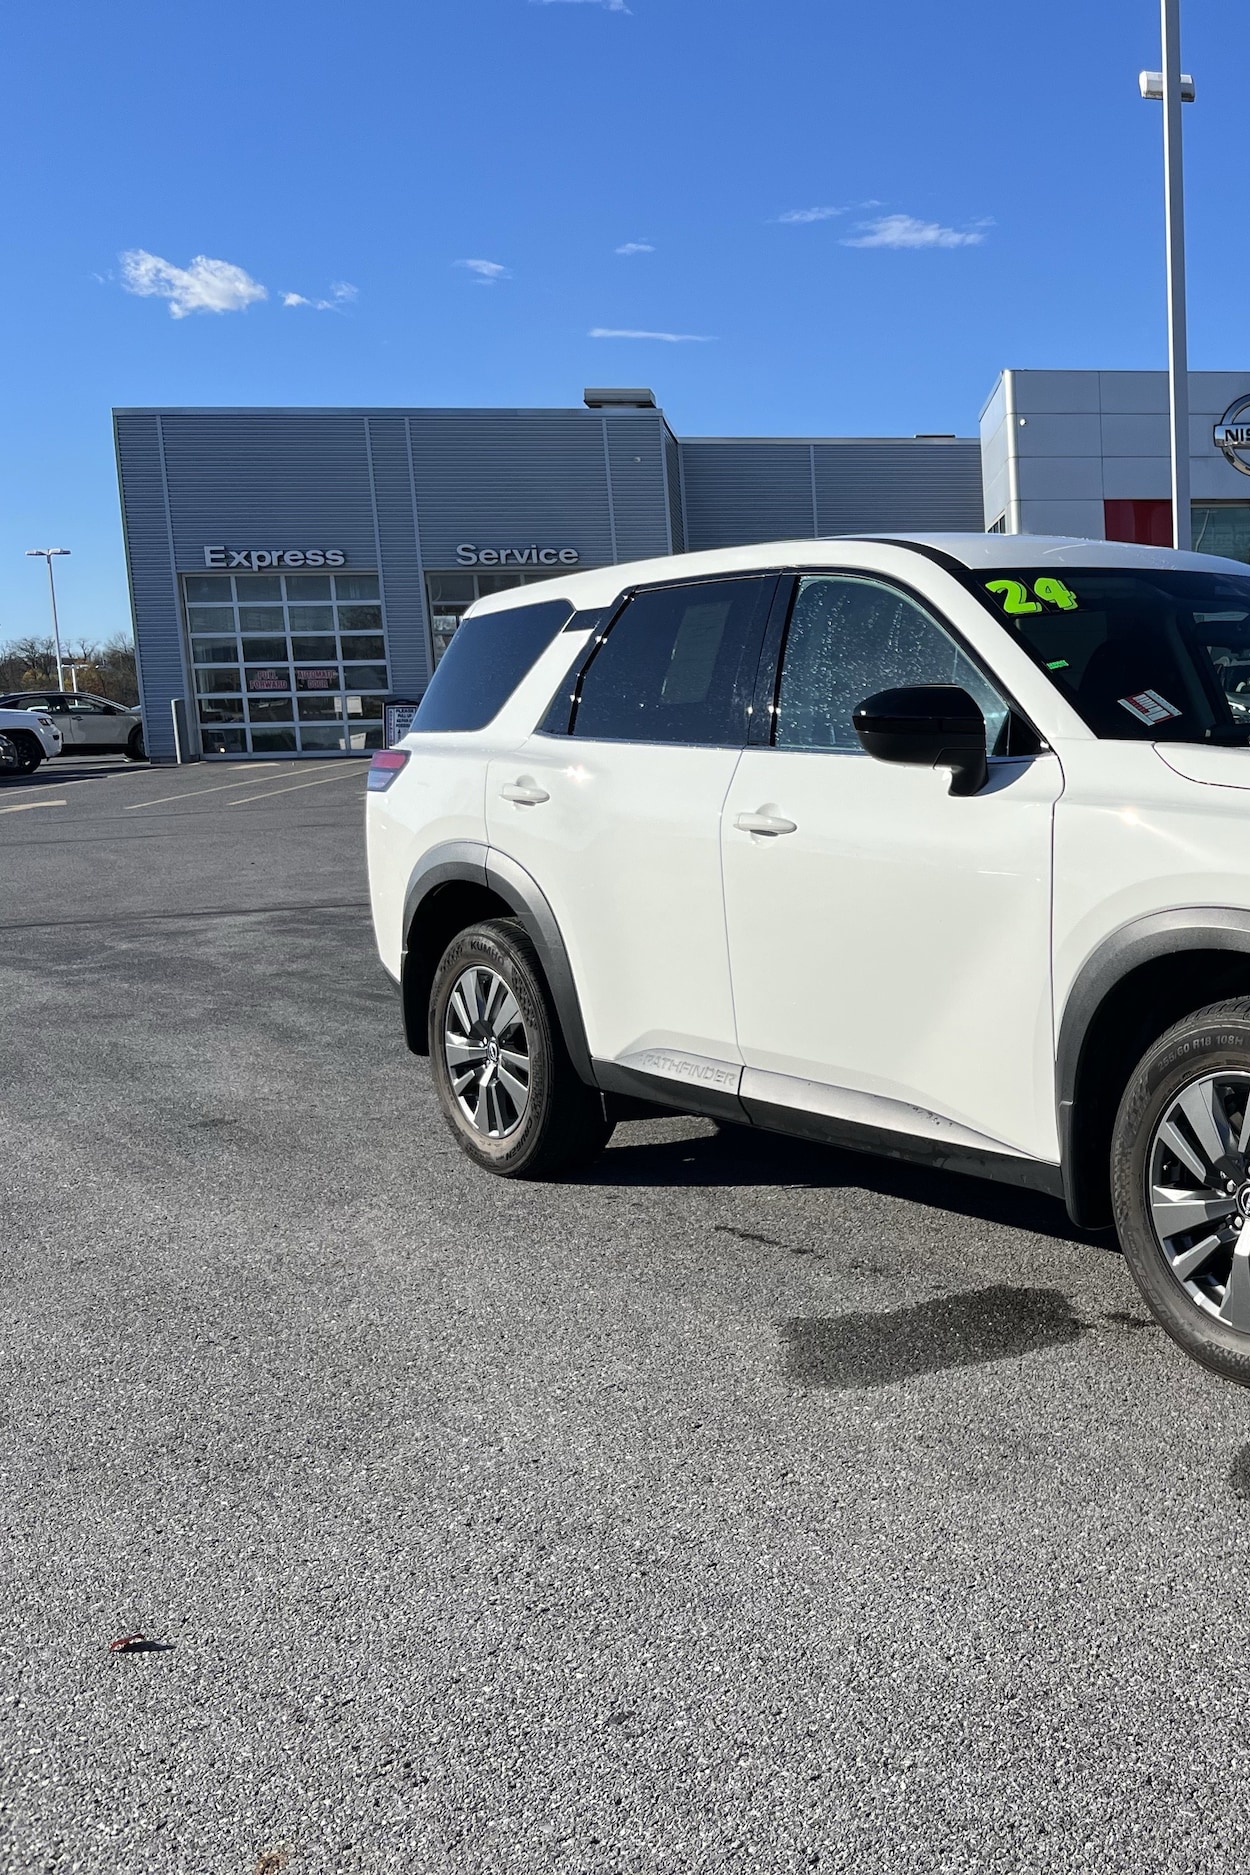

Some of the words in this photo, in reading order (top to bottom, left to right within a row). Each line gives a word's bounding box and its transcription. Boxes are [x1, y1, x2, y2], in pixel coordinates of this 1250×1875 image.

[203, 545, 345, 572] Express
[456, 543, 579, 566] Service
[985, 577, 1079, 614] 24
[470, 940, 504, 966] KUMHO
[643, 1054, 737, 1086] PATHFINDER
